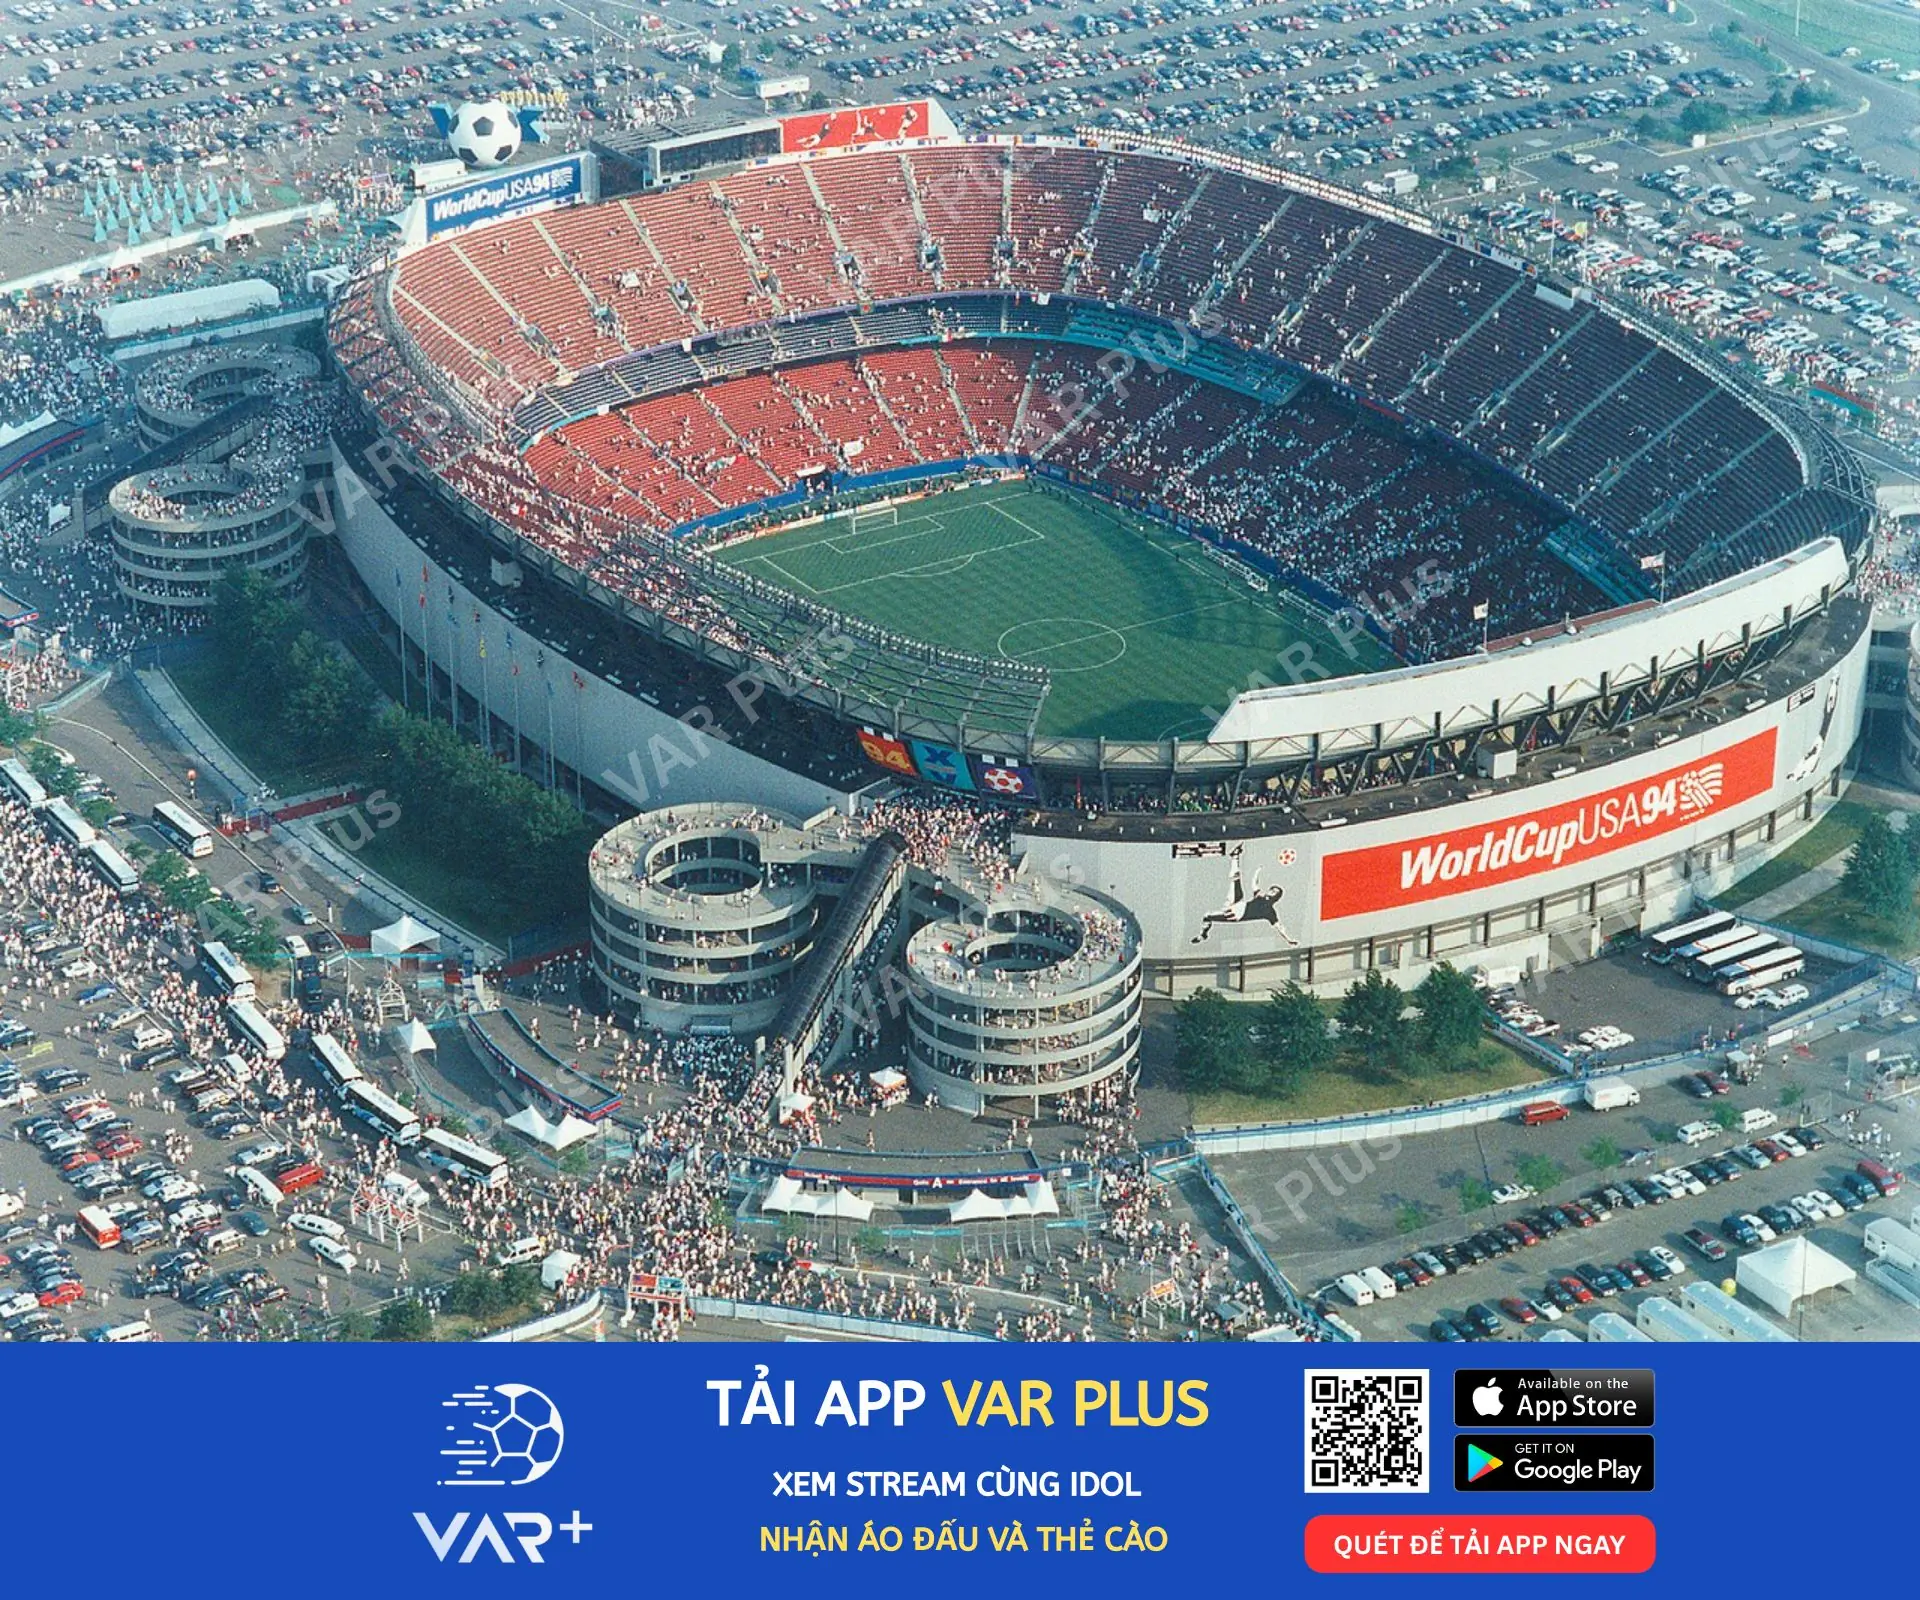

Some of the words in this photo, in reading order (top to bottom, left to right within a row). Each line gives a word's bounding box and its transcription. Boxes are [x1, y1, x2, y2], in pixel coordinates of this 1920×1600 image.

[862, 741, 909, 769] 94
[1400, 778, 1677, 890] WorldCupUSA94
[932, 1177, 943, 1188] A
